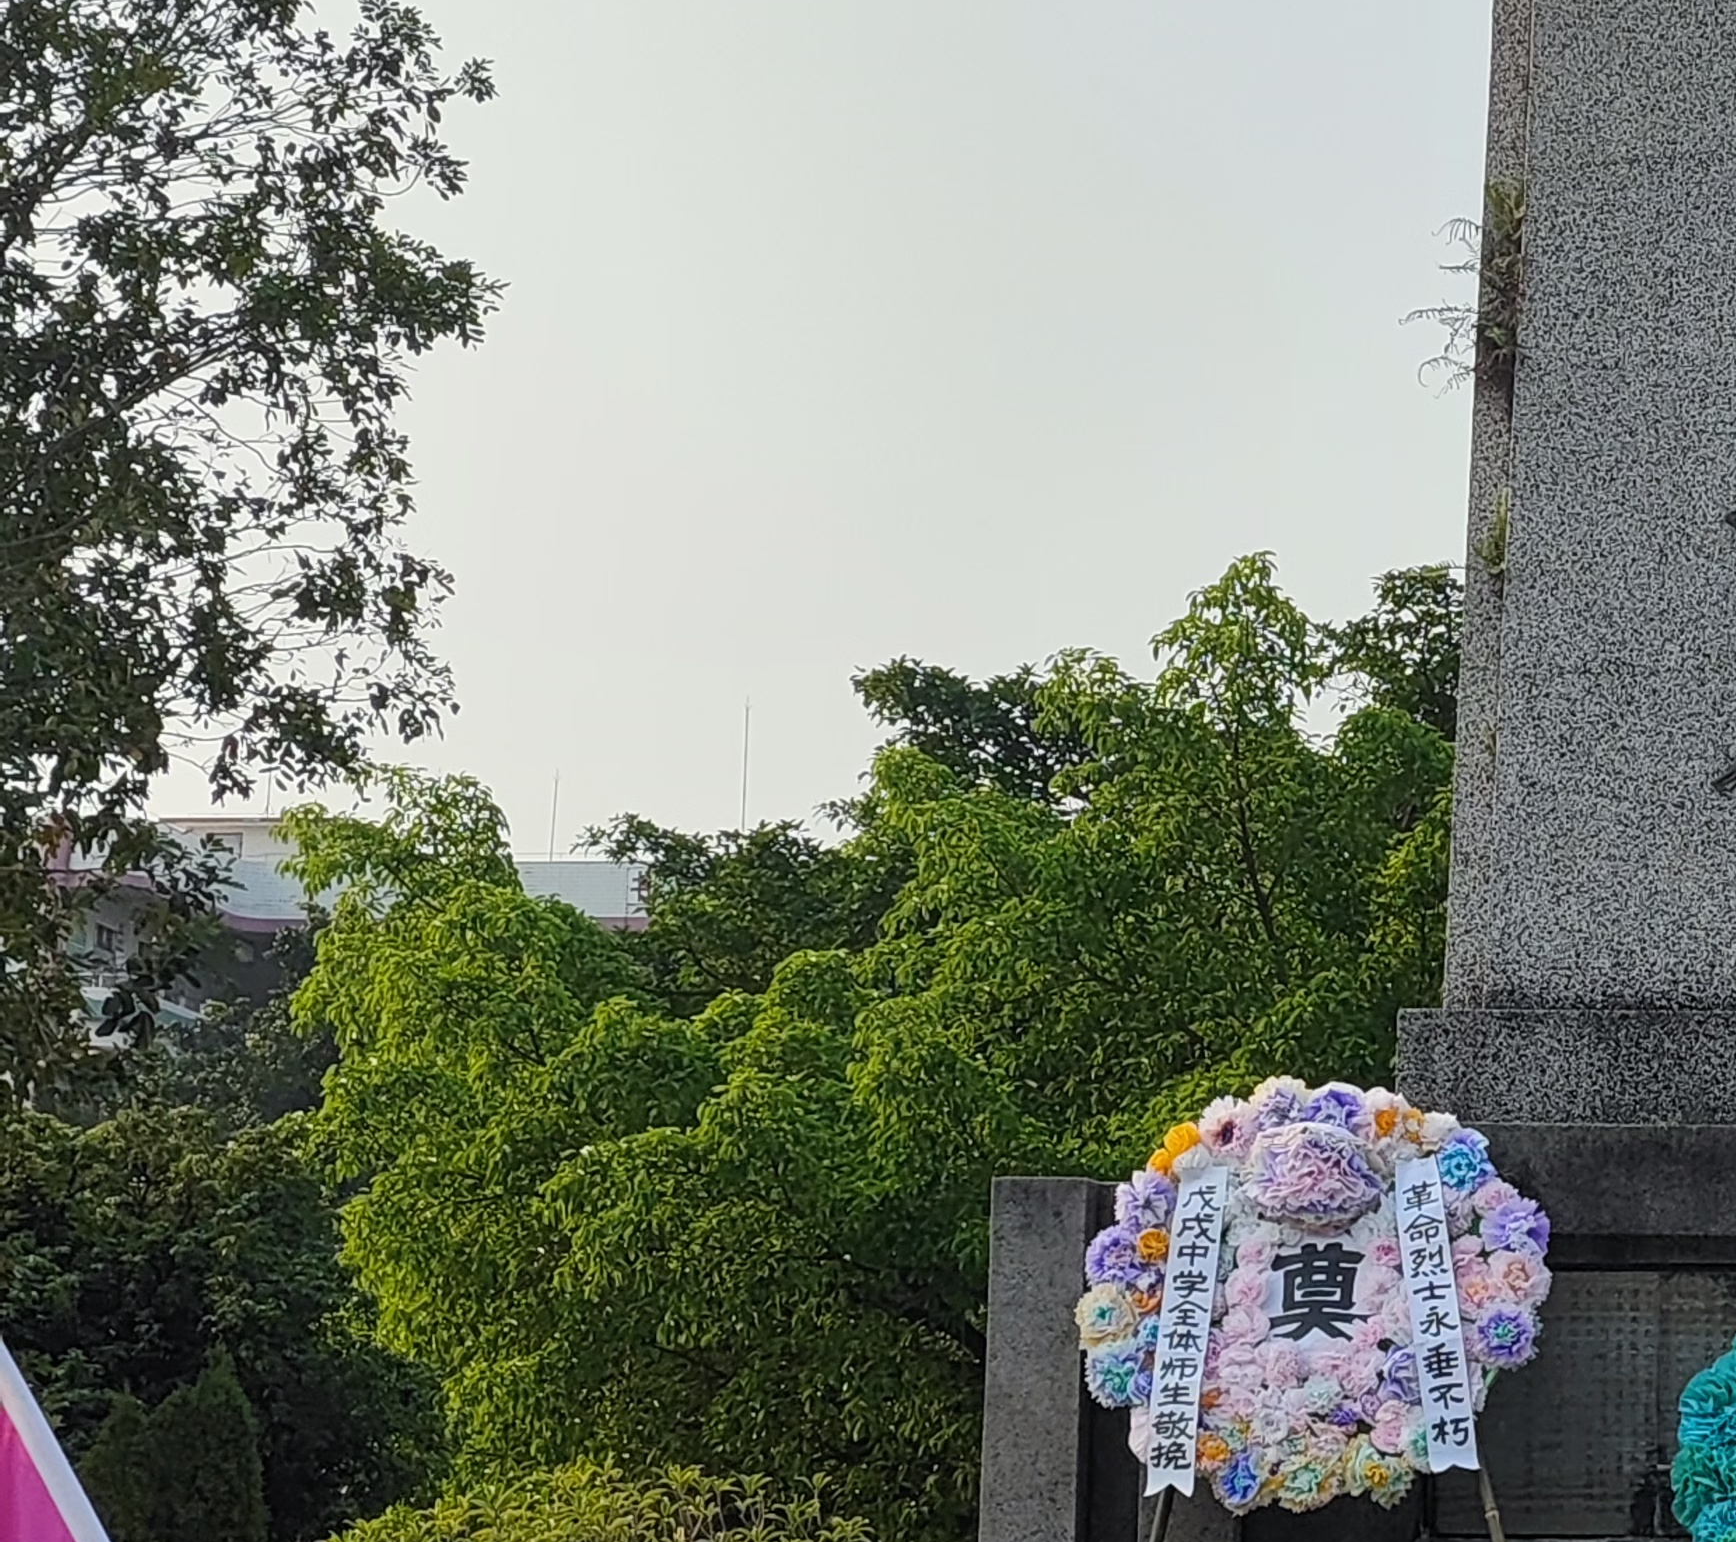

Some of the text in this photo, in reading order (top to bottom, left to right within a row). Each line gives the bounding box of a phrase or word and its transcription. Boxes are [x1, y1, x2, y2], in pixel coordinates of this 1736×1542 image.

[1150, 1185, 1221, 1471] 戊戌中学全体师生敬挽
[1268, 1241, 1368, 1341] 奠
[1401, 1180, 1471, 1447] 革命烈士永垂不朽
